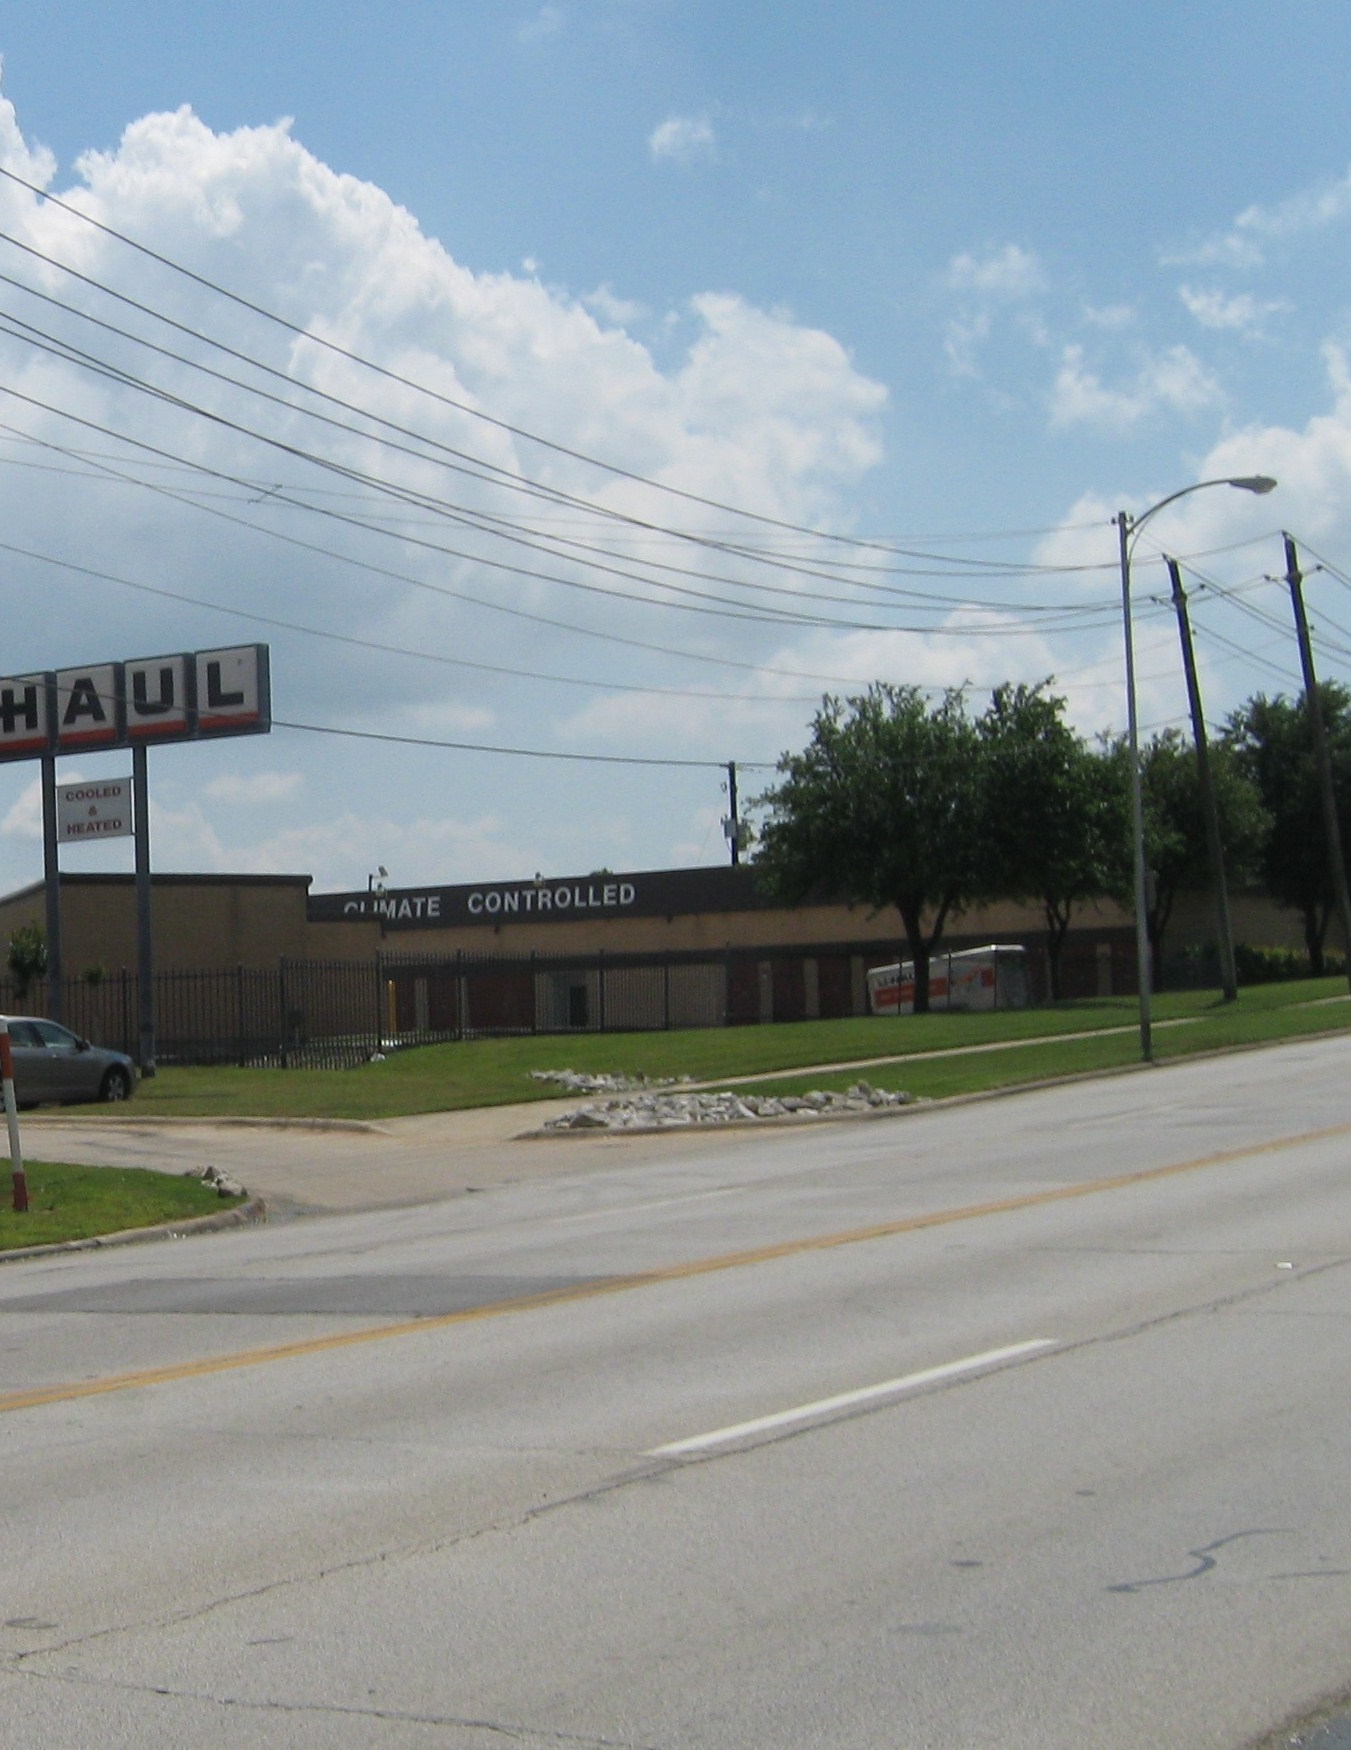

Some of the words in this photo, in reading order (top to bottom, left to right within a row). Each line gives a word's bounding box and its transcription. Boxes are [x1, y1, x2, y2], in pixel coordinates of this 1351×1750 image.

[65, 786, 122, 802] COOLED
[67, 819, 122, 835] HEATED
[467, 883, 637, 914] CONTROLLED
